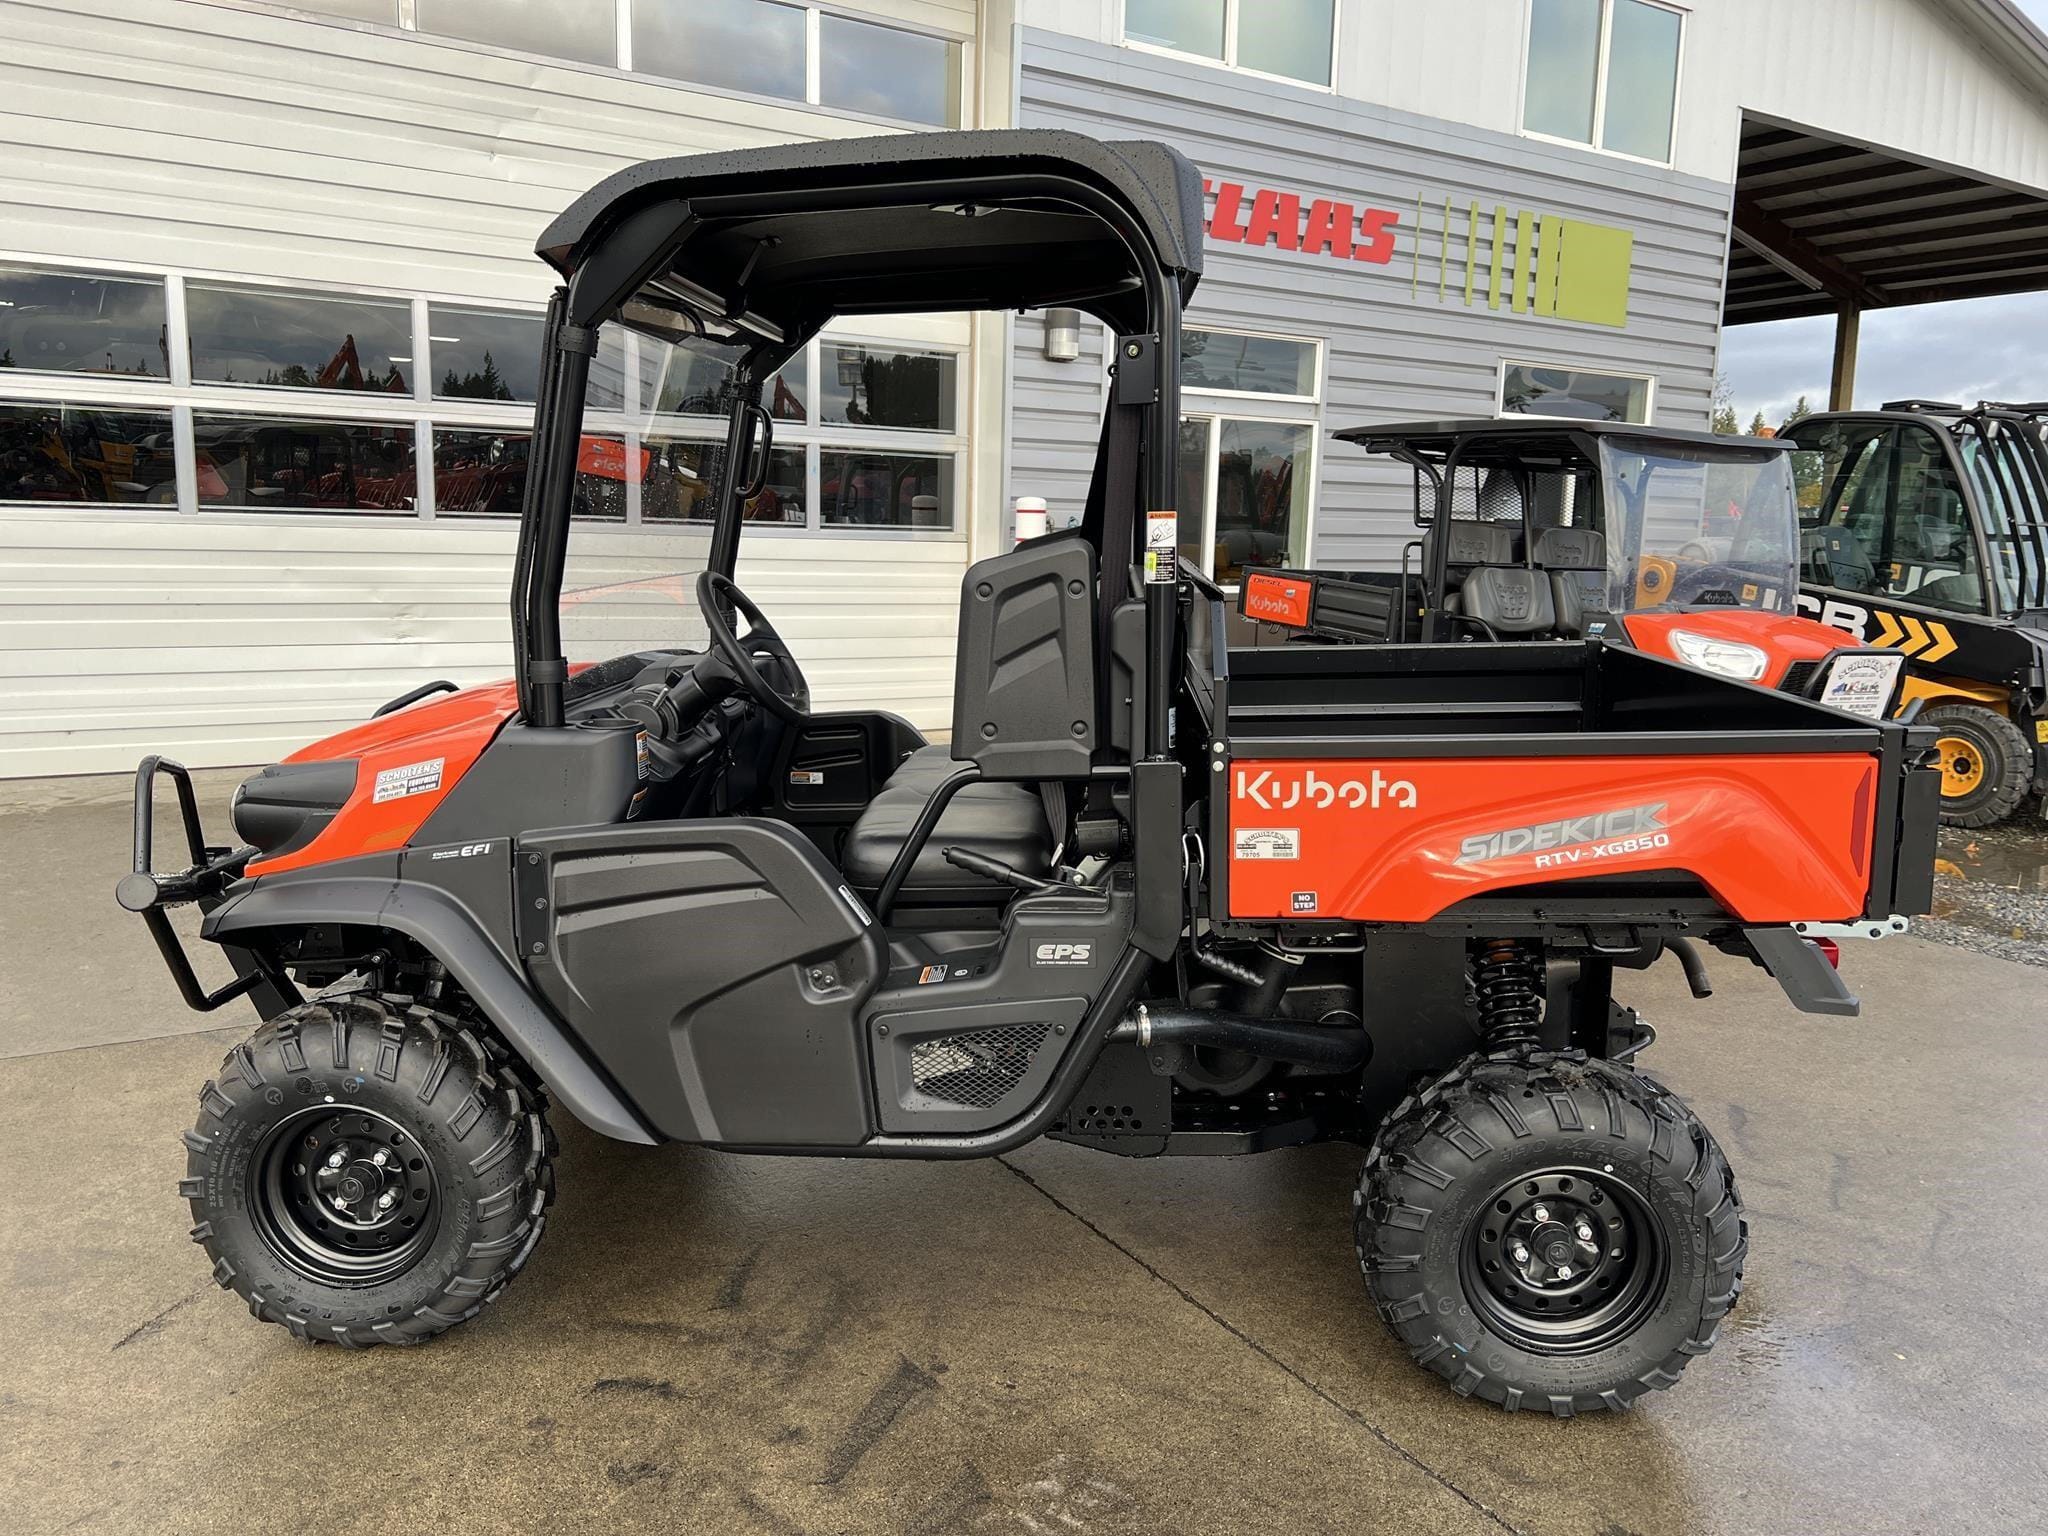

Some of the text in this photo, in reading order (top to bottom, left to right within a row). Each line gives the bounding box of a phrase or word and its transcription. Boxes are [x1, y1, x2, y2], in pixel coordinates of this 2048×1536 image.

[1202, 179, 1400, 266] LAAS
[1250, 595, 1289, 615] Kubota
[1703, 592, 1734, 604] Kubota
[379, 761, 441, 783] SCHOLTEN'S
[408, 774, 439, 787] EQUIPMENT
[1236, 769, 1417, 810] Kubota
[1452, 802, 1668, 866] SIDEKICK
[461, 842, 490, 857] EFI
[1535, 833, 1670, 868] RTV-XG850
[1298, 894, 1311, 902] NO
[1036, 944, 1091, 960] EPS
